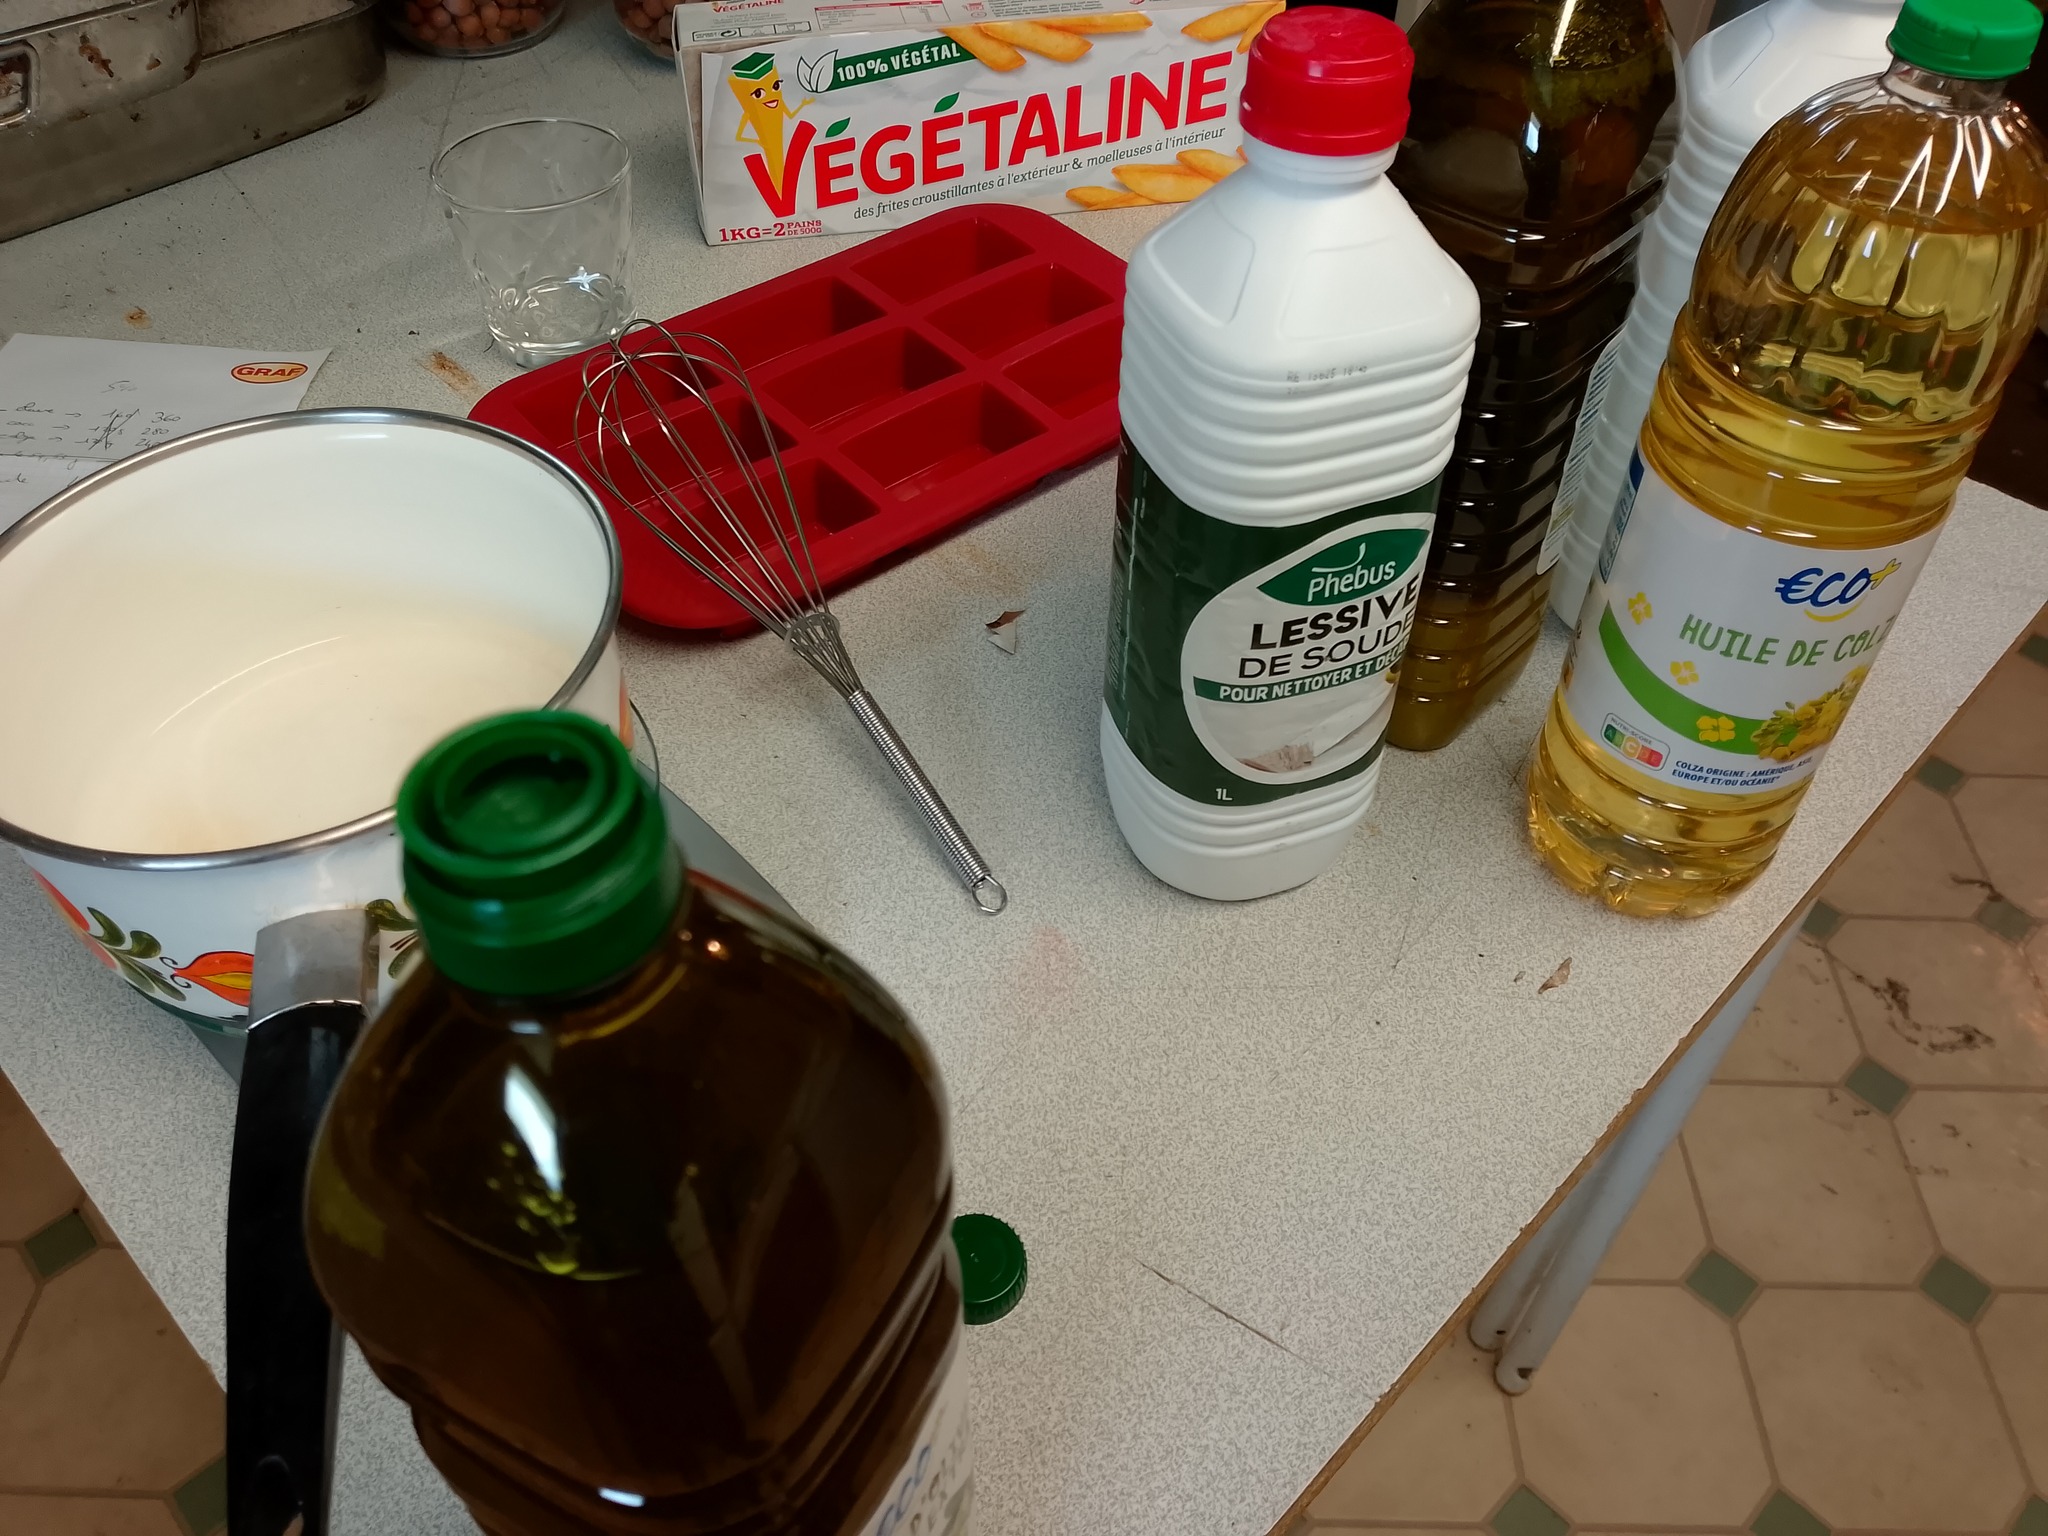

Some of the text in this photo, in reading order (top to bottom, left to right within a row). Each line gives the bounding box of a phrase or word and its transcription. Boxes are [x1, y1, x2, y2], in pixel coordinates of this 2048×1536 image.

[837, 42, 960, 82] 100% VÉGÉTAL
[744, 51, 1233, 218] VÉGÉTALINE
[853, 127, 1226, 220] des frites croustillantes à l'extérieur & moelleuses à l'intérieur
[787, 219, 822, 229] PAINS
[800, 227, 822, 235] 500G
[236, 367, 304, 377] GRAF
[1307, 560, 1396, 602] Phebus
[1250, 573, 1420, 650] LESSIVE
[1239, 608, 1416, 679] DE SOUDE
[1679, 613, 1780, 665] HUILE
[1785, 639, 1829, 667] DE
[1219, 685, 1268, 701] POUR
[1271, 668, 1350, 699] NETTOYER
[1355, 660, 1371, 678] ET
[1672, 769, 1709, 784] EUROPE
[1710, 777, 1738, 786] ET/OU
[1675, 760, 1704, 773] COLZA
[1706, 767, 1745, 778] ORIGINE
[1216, 788, 1233, 802] 1L
